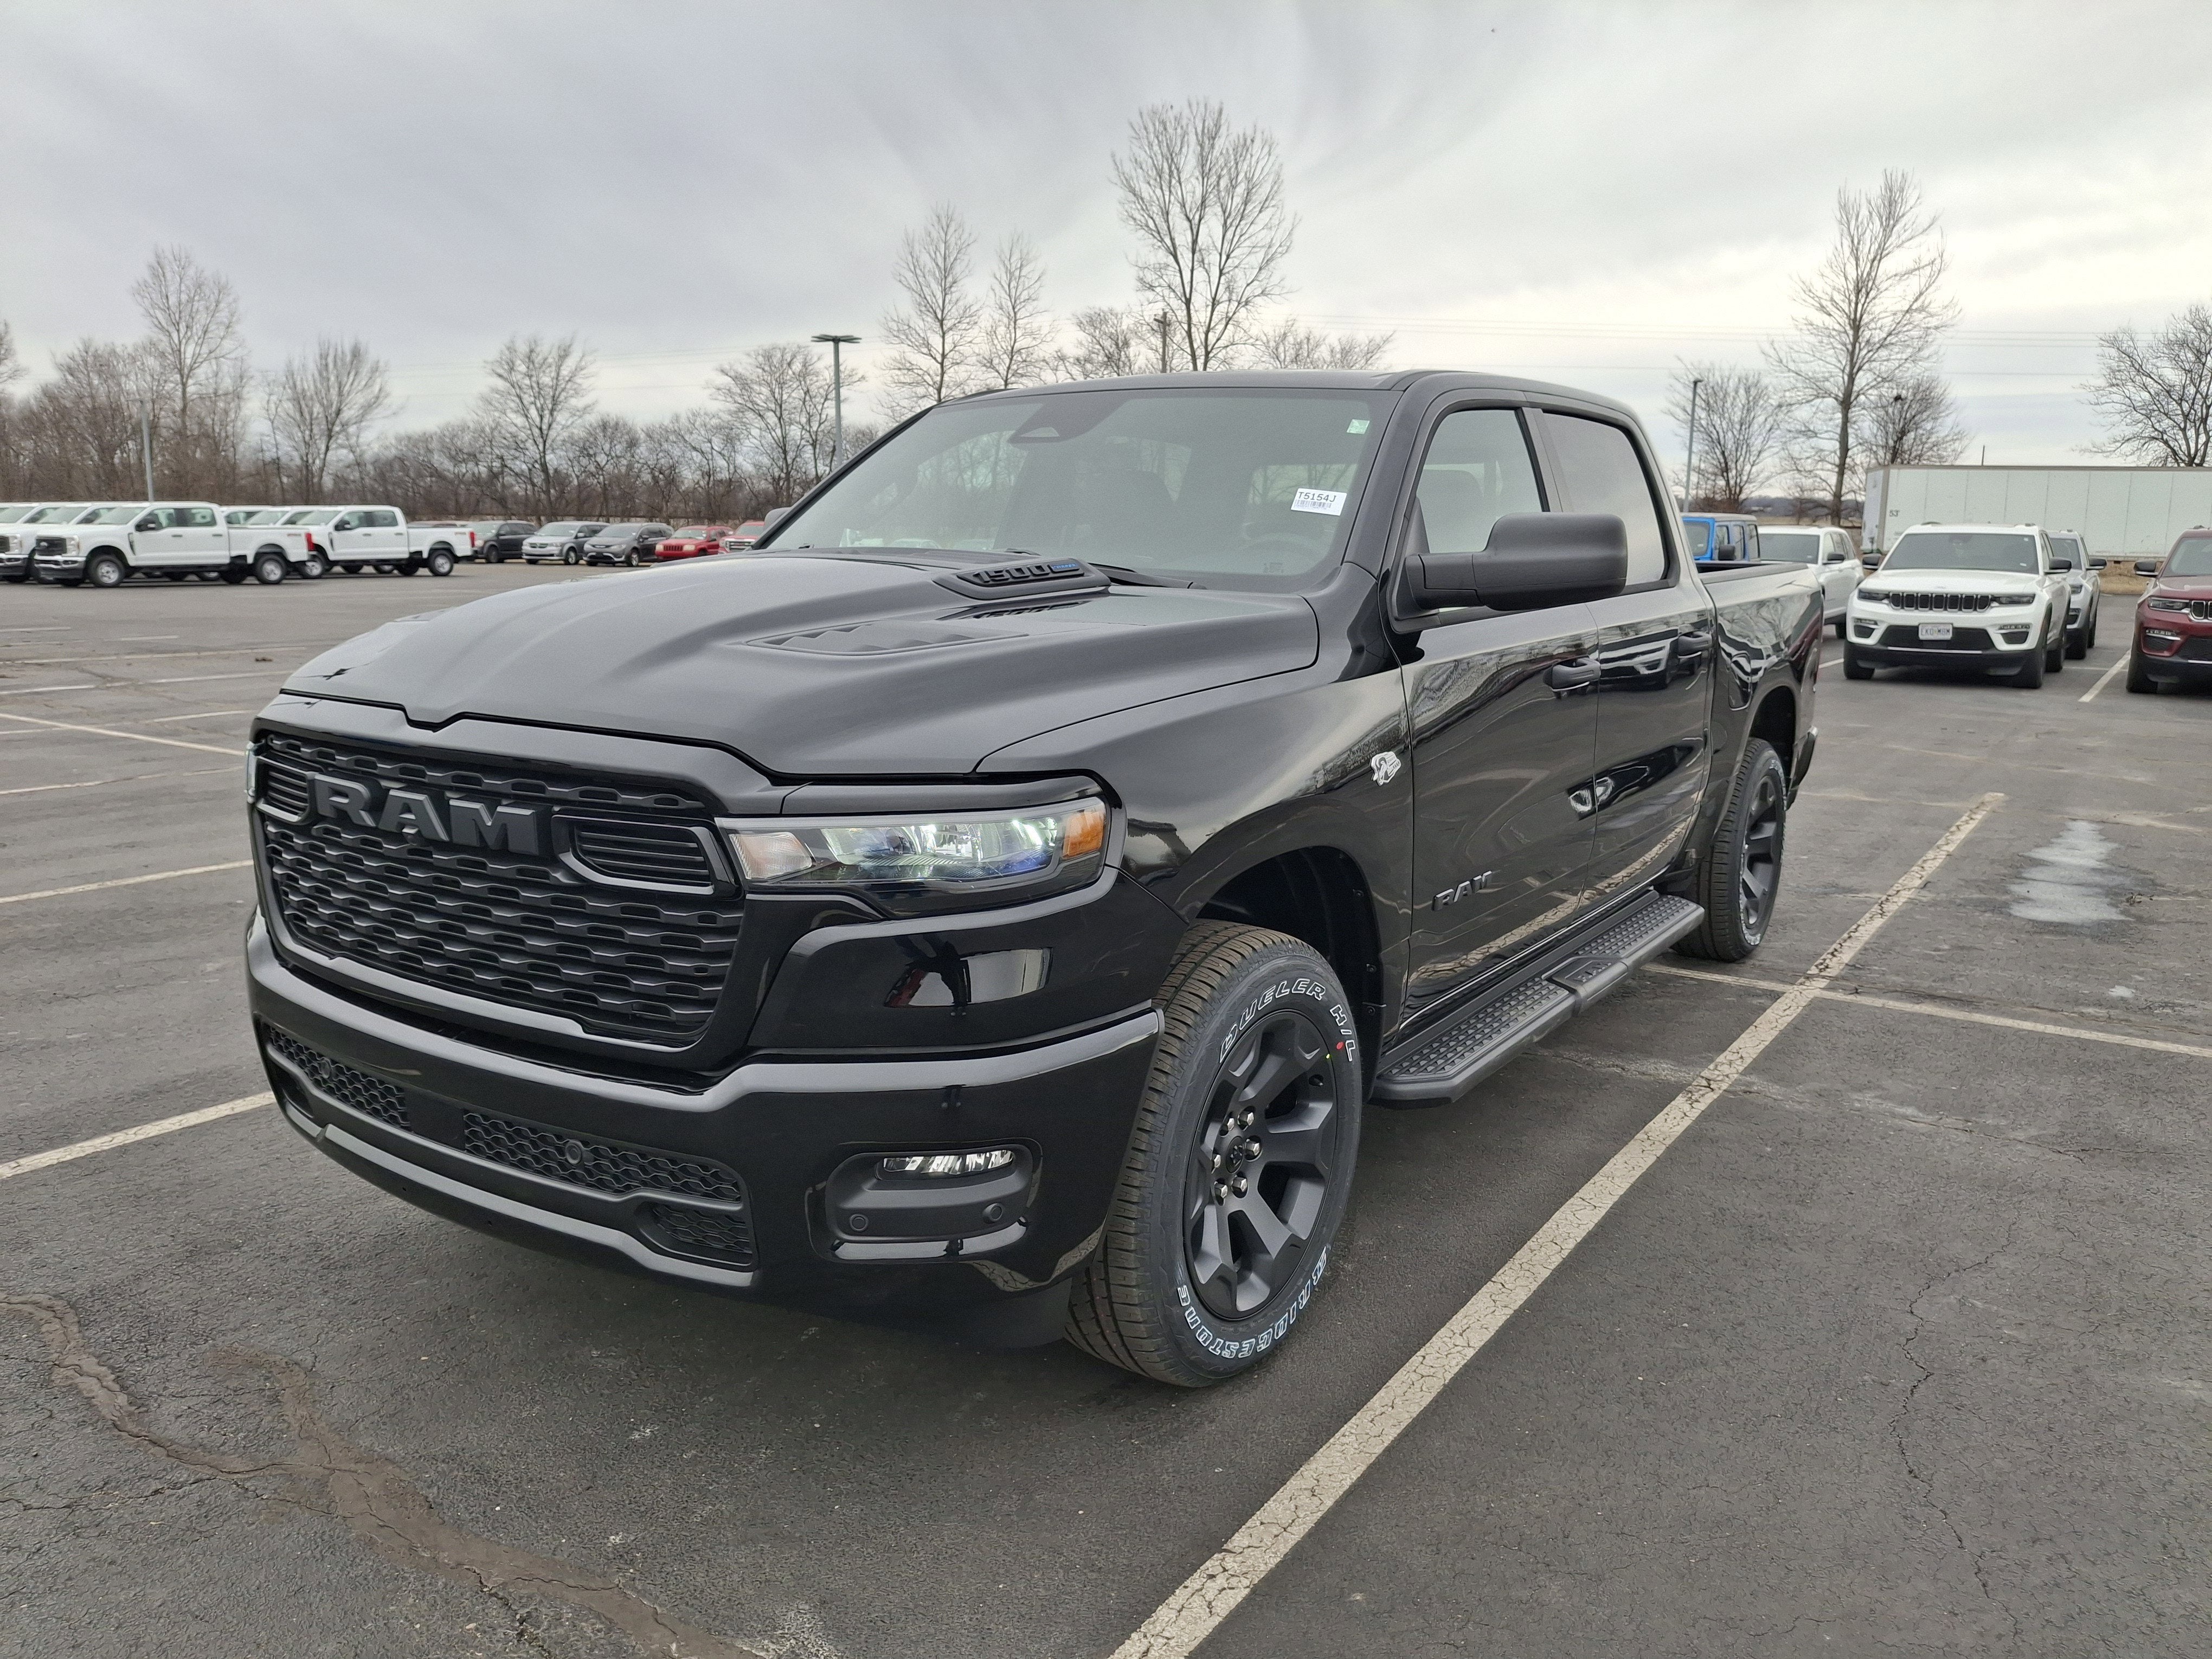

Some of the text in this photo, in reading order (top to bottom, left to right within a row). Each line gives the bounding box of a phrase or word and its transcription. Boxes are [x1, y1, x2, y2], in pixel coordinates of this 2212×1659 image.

[1298, 492, 1337, 503] T5154J
[973, 564, 1050, 583] 1500
[314, 772, 540, 857] RAM
[1431, 870, 1493, 911] RAM
[1220, 978, 1326, 1063] DUELER
[1177, 1245, 1329, 1359] BRIDGESTONE
